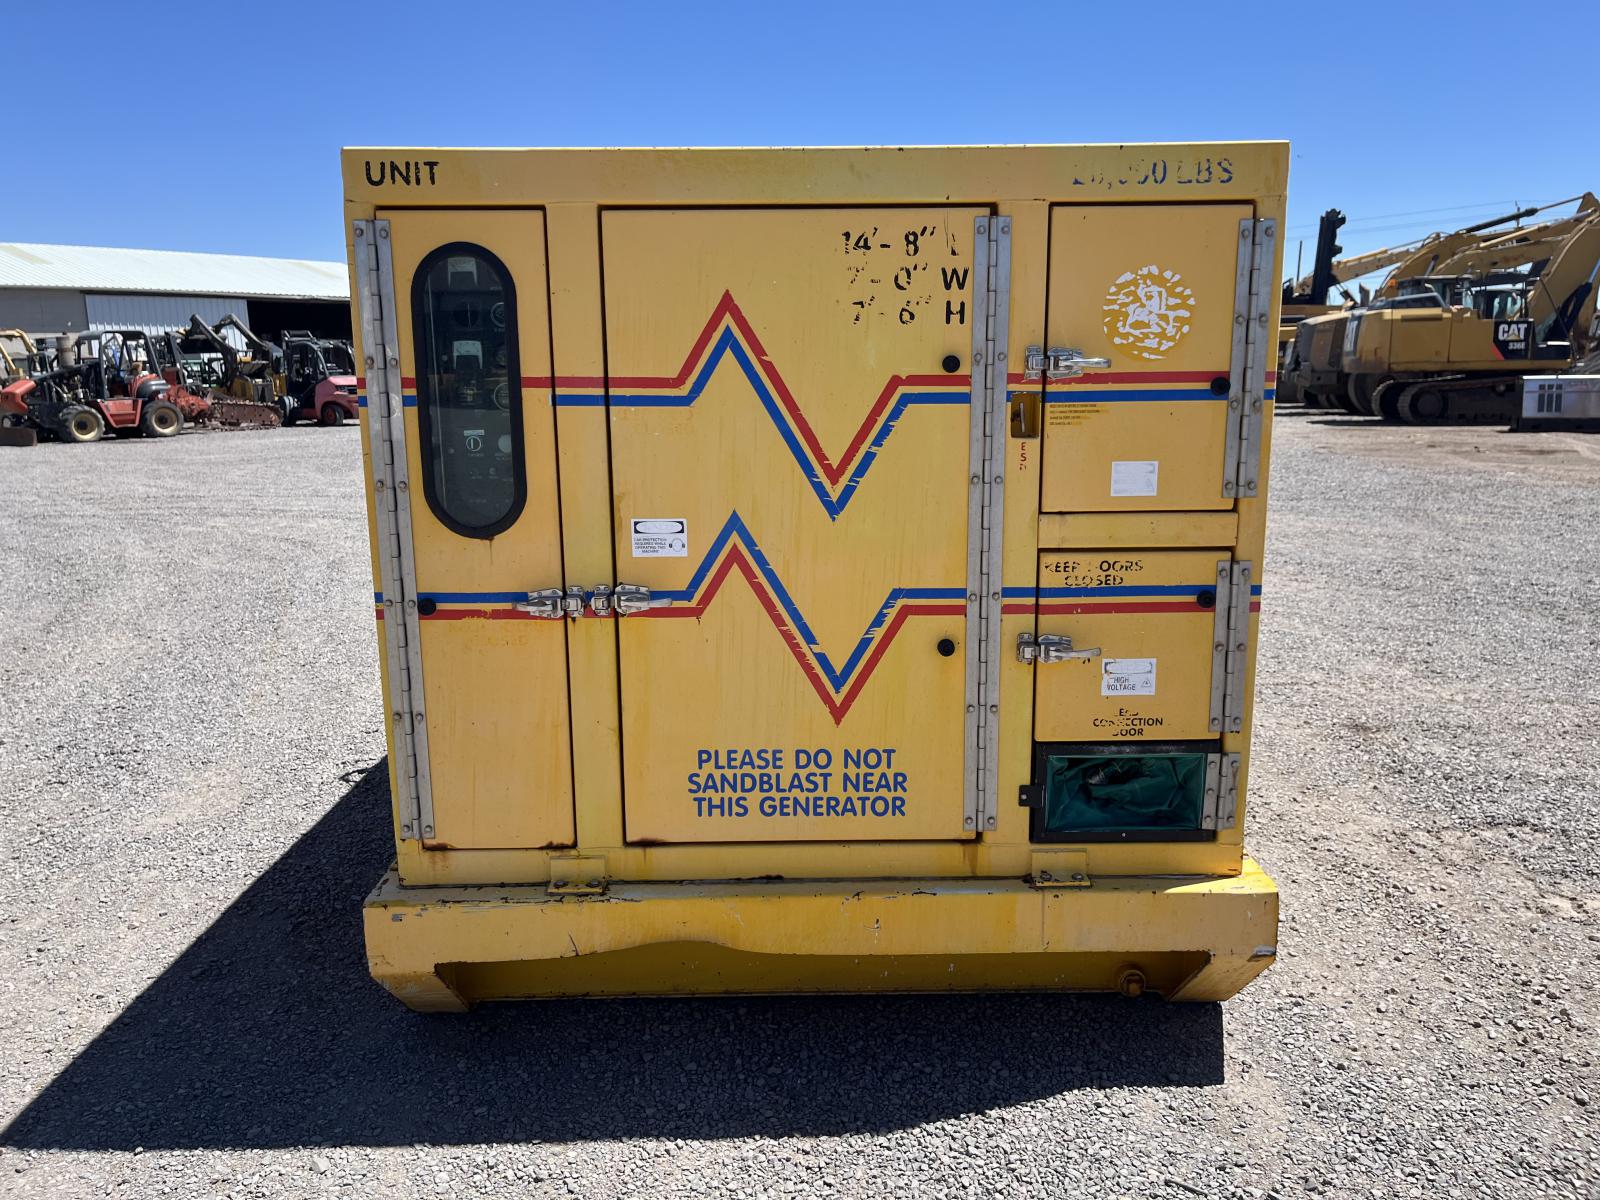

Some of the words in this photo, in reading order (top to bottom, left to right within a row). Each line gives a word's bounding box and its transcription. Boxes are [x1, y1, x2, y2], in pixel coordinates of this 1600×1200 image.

[365, 160, 440, 187] UNIT
[941, 266, 970, 291] W
[945, 299, 966, 325] H
[1498, 323, 1527, 340] CAT
[1106, 683, 1136, 691] VOLTAGE
[1113, 676, 1130, 684] HIGH
[697, 748, 784, 770] PLEASE
[795, 748, 832, 770] DO
[843, 748, 897, 770] NOT
[687, 771, 833, 794] SANDBLAST
[842, 771, 908, 793] NEAR
[693, 795, 749, 818] THIS
[759, 795, 906, 818] GENERATOR
